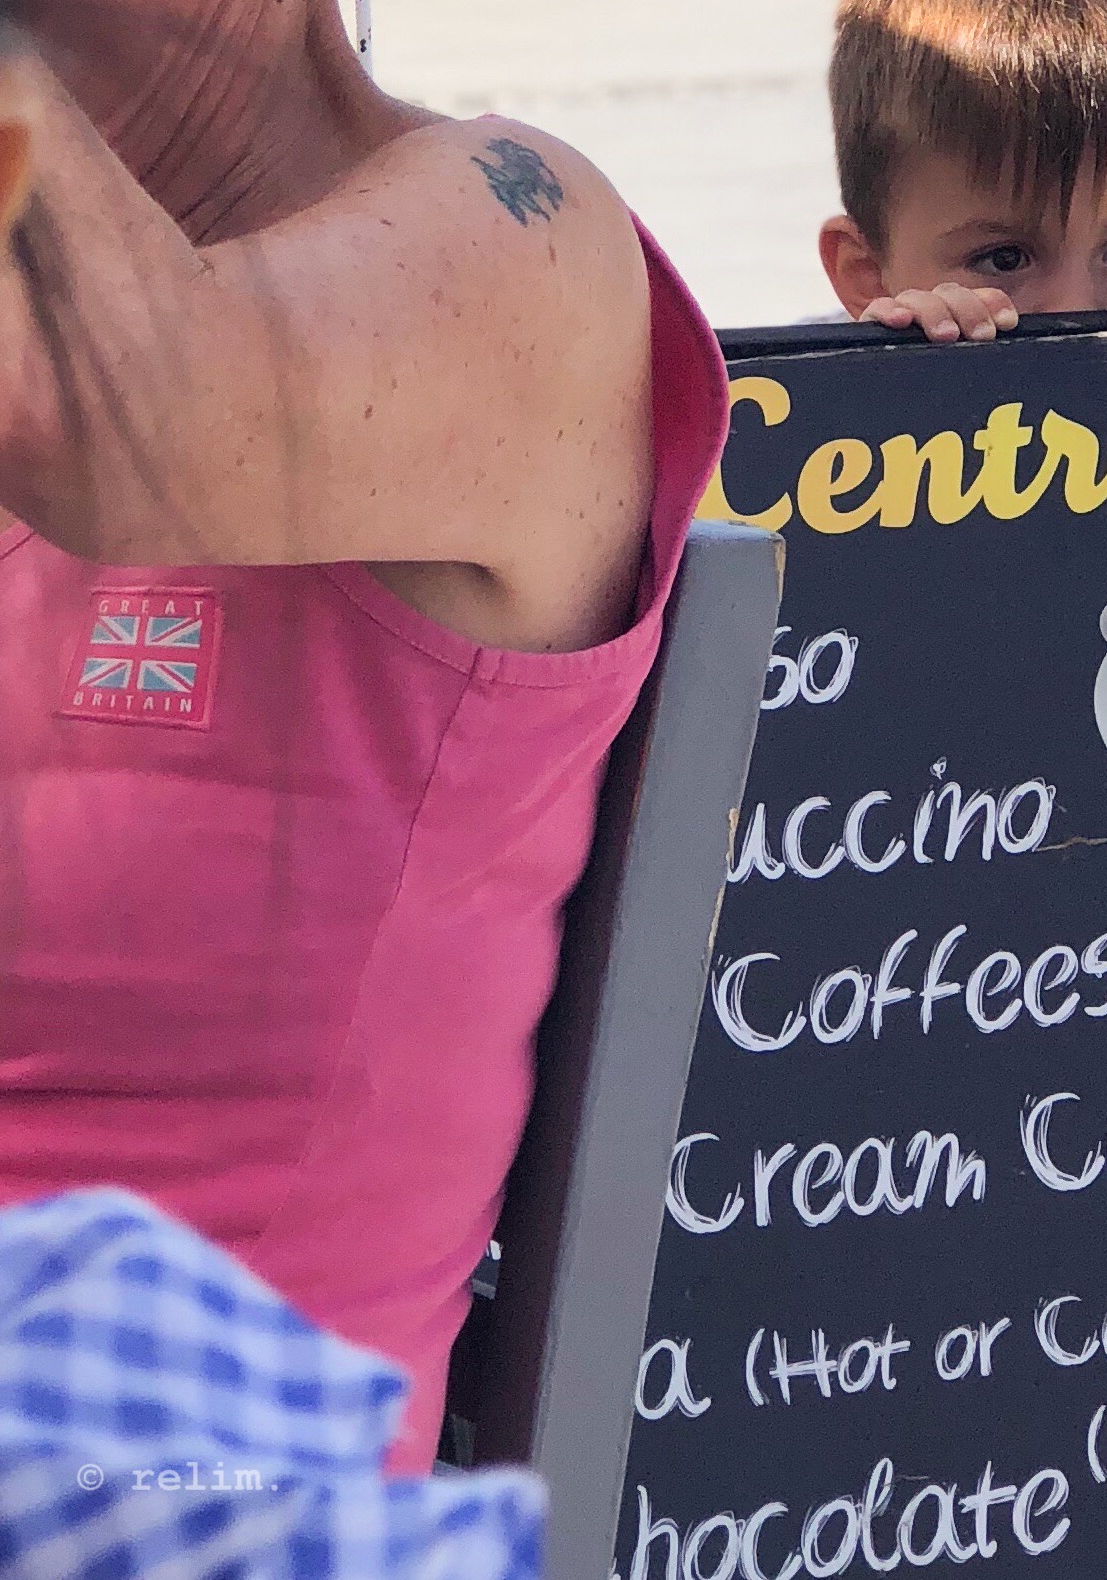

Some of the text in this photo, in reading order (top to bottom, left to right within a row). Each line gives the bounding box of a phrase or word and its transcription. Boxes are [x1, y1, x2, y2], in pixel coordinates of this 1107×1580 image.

[99, 599, 204, 616] GREAT
[72, 691, 193, 713] BRITAIN
[665, 1131, 987, 1233] Cream
[745, 1322, 911, 1406] (Hot
[935, 1317, 1012, 1382] or
[608, 1457, 1071, 1580] hocolate
